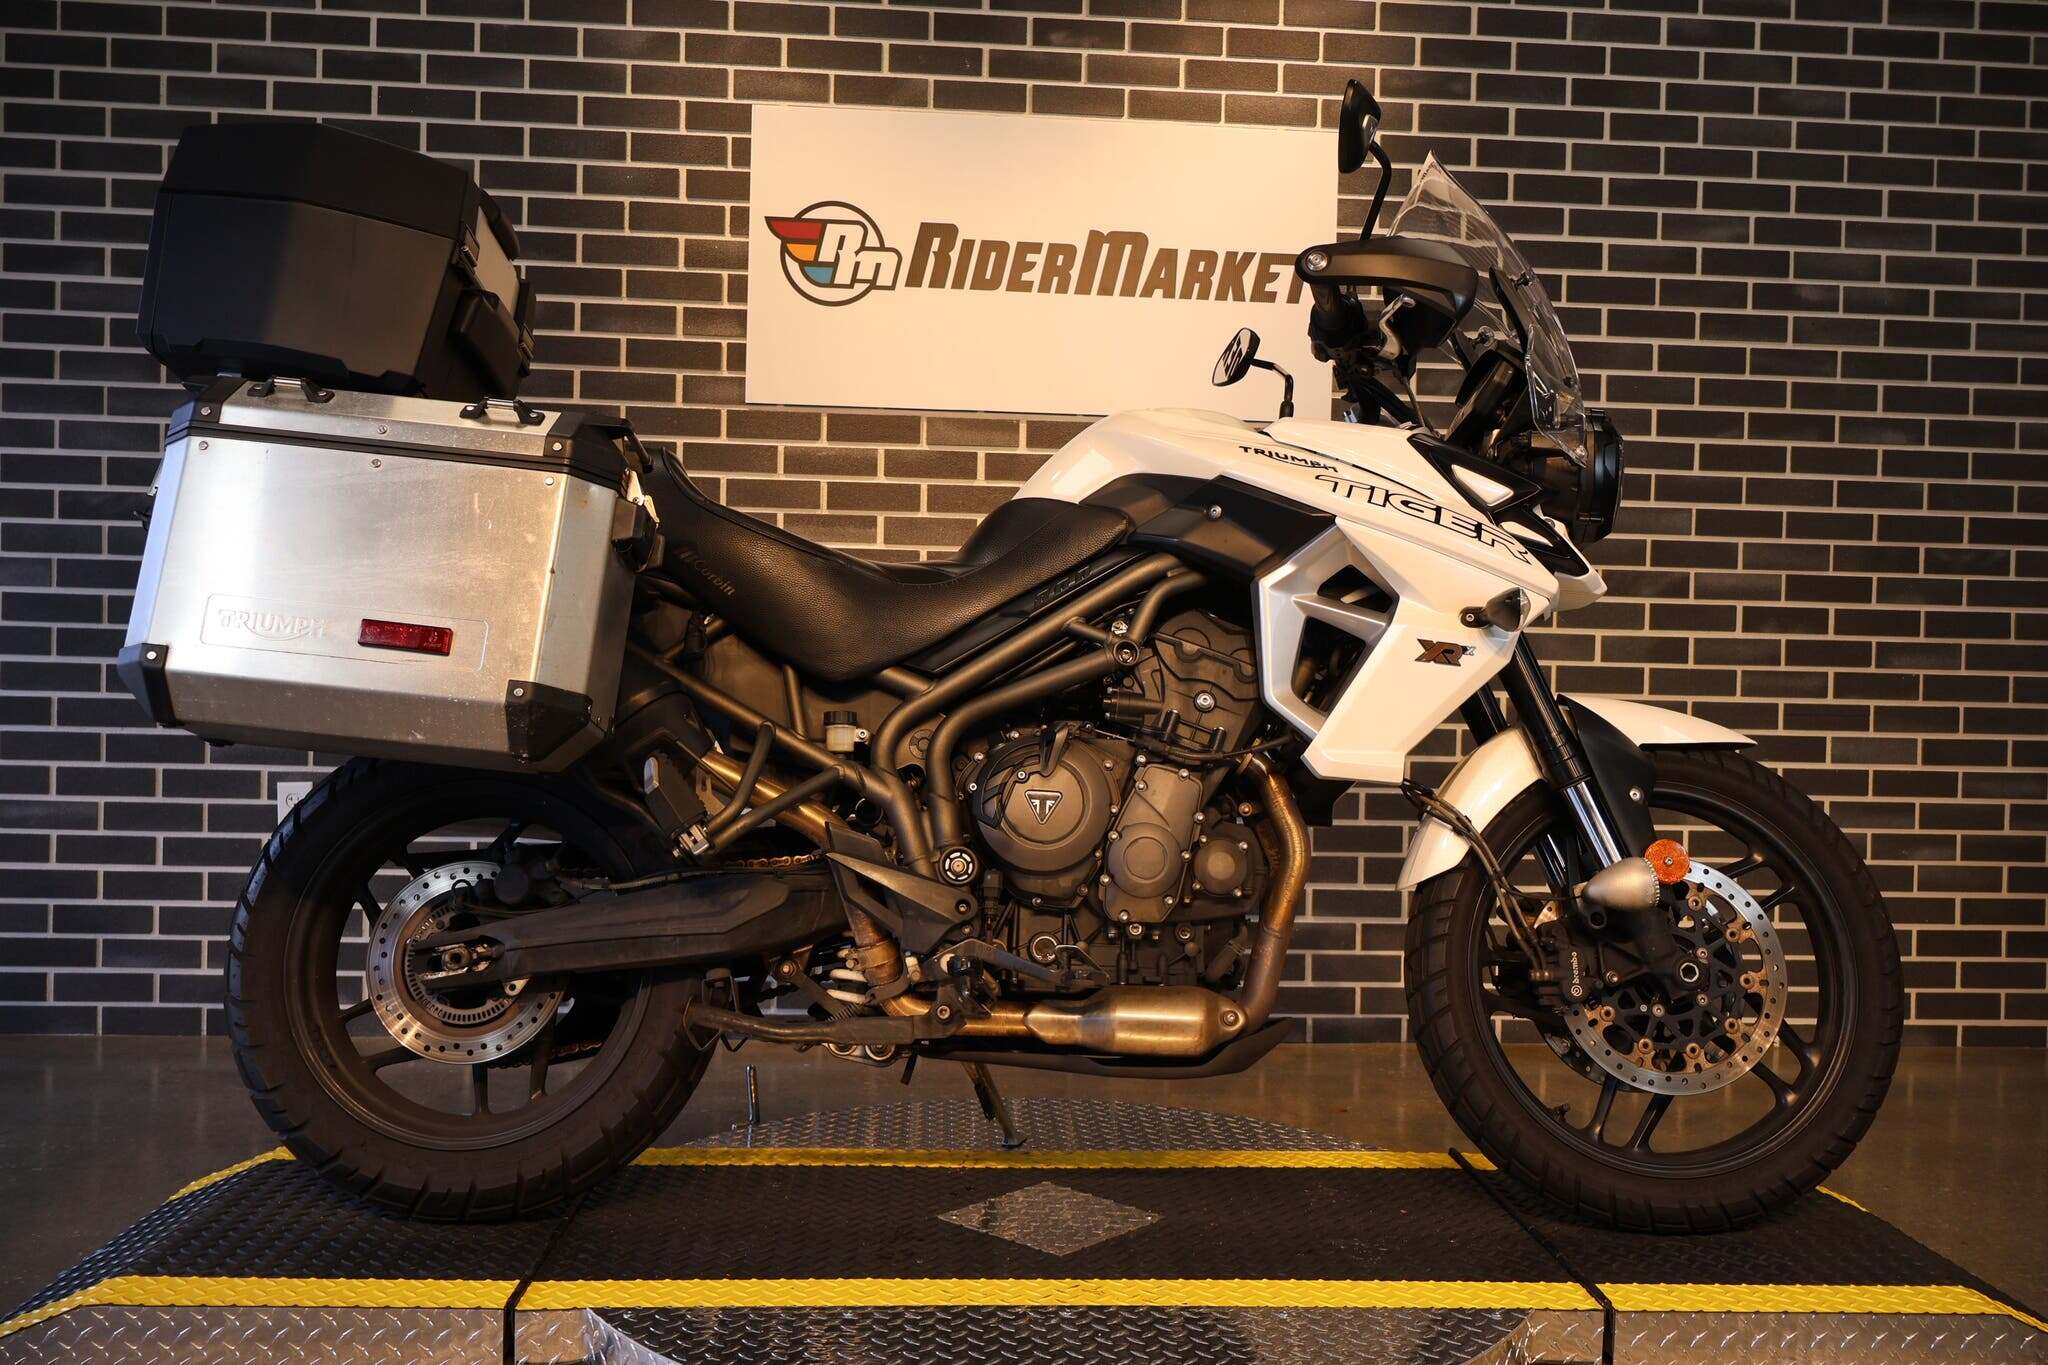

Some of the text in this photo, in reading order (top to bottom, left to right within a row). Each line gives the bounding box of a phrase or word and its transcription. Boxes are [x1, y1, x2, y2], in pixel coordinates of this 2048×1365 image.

[1238, 445, 1338, 473] TRIUMPH
[1314, 474, 1532, 566] TIGER
[217, 608, 327, 642] TRIUMPH
[1570, 951, 1580, 984] brembo
